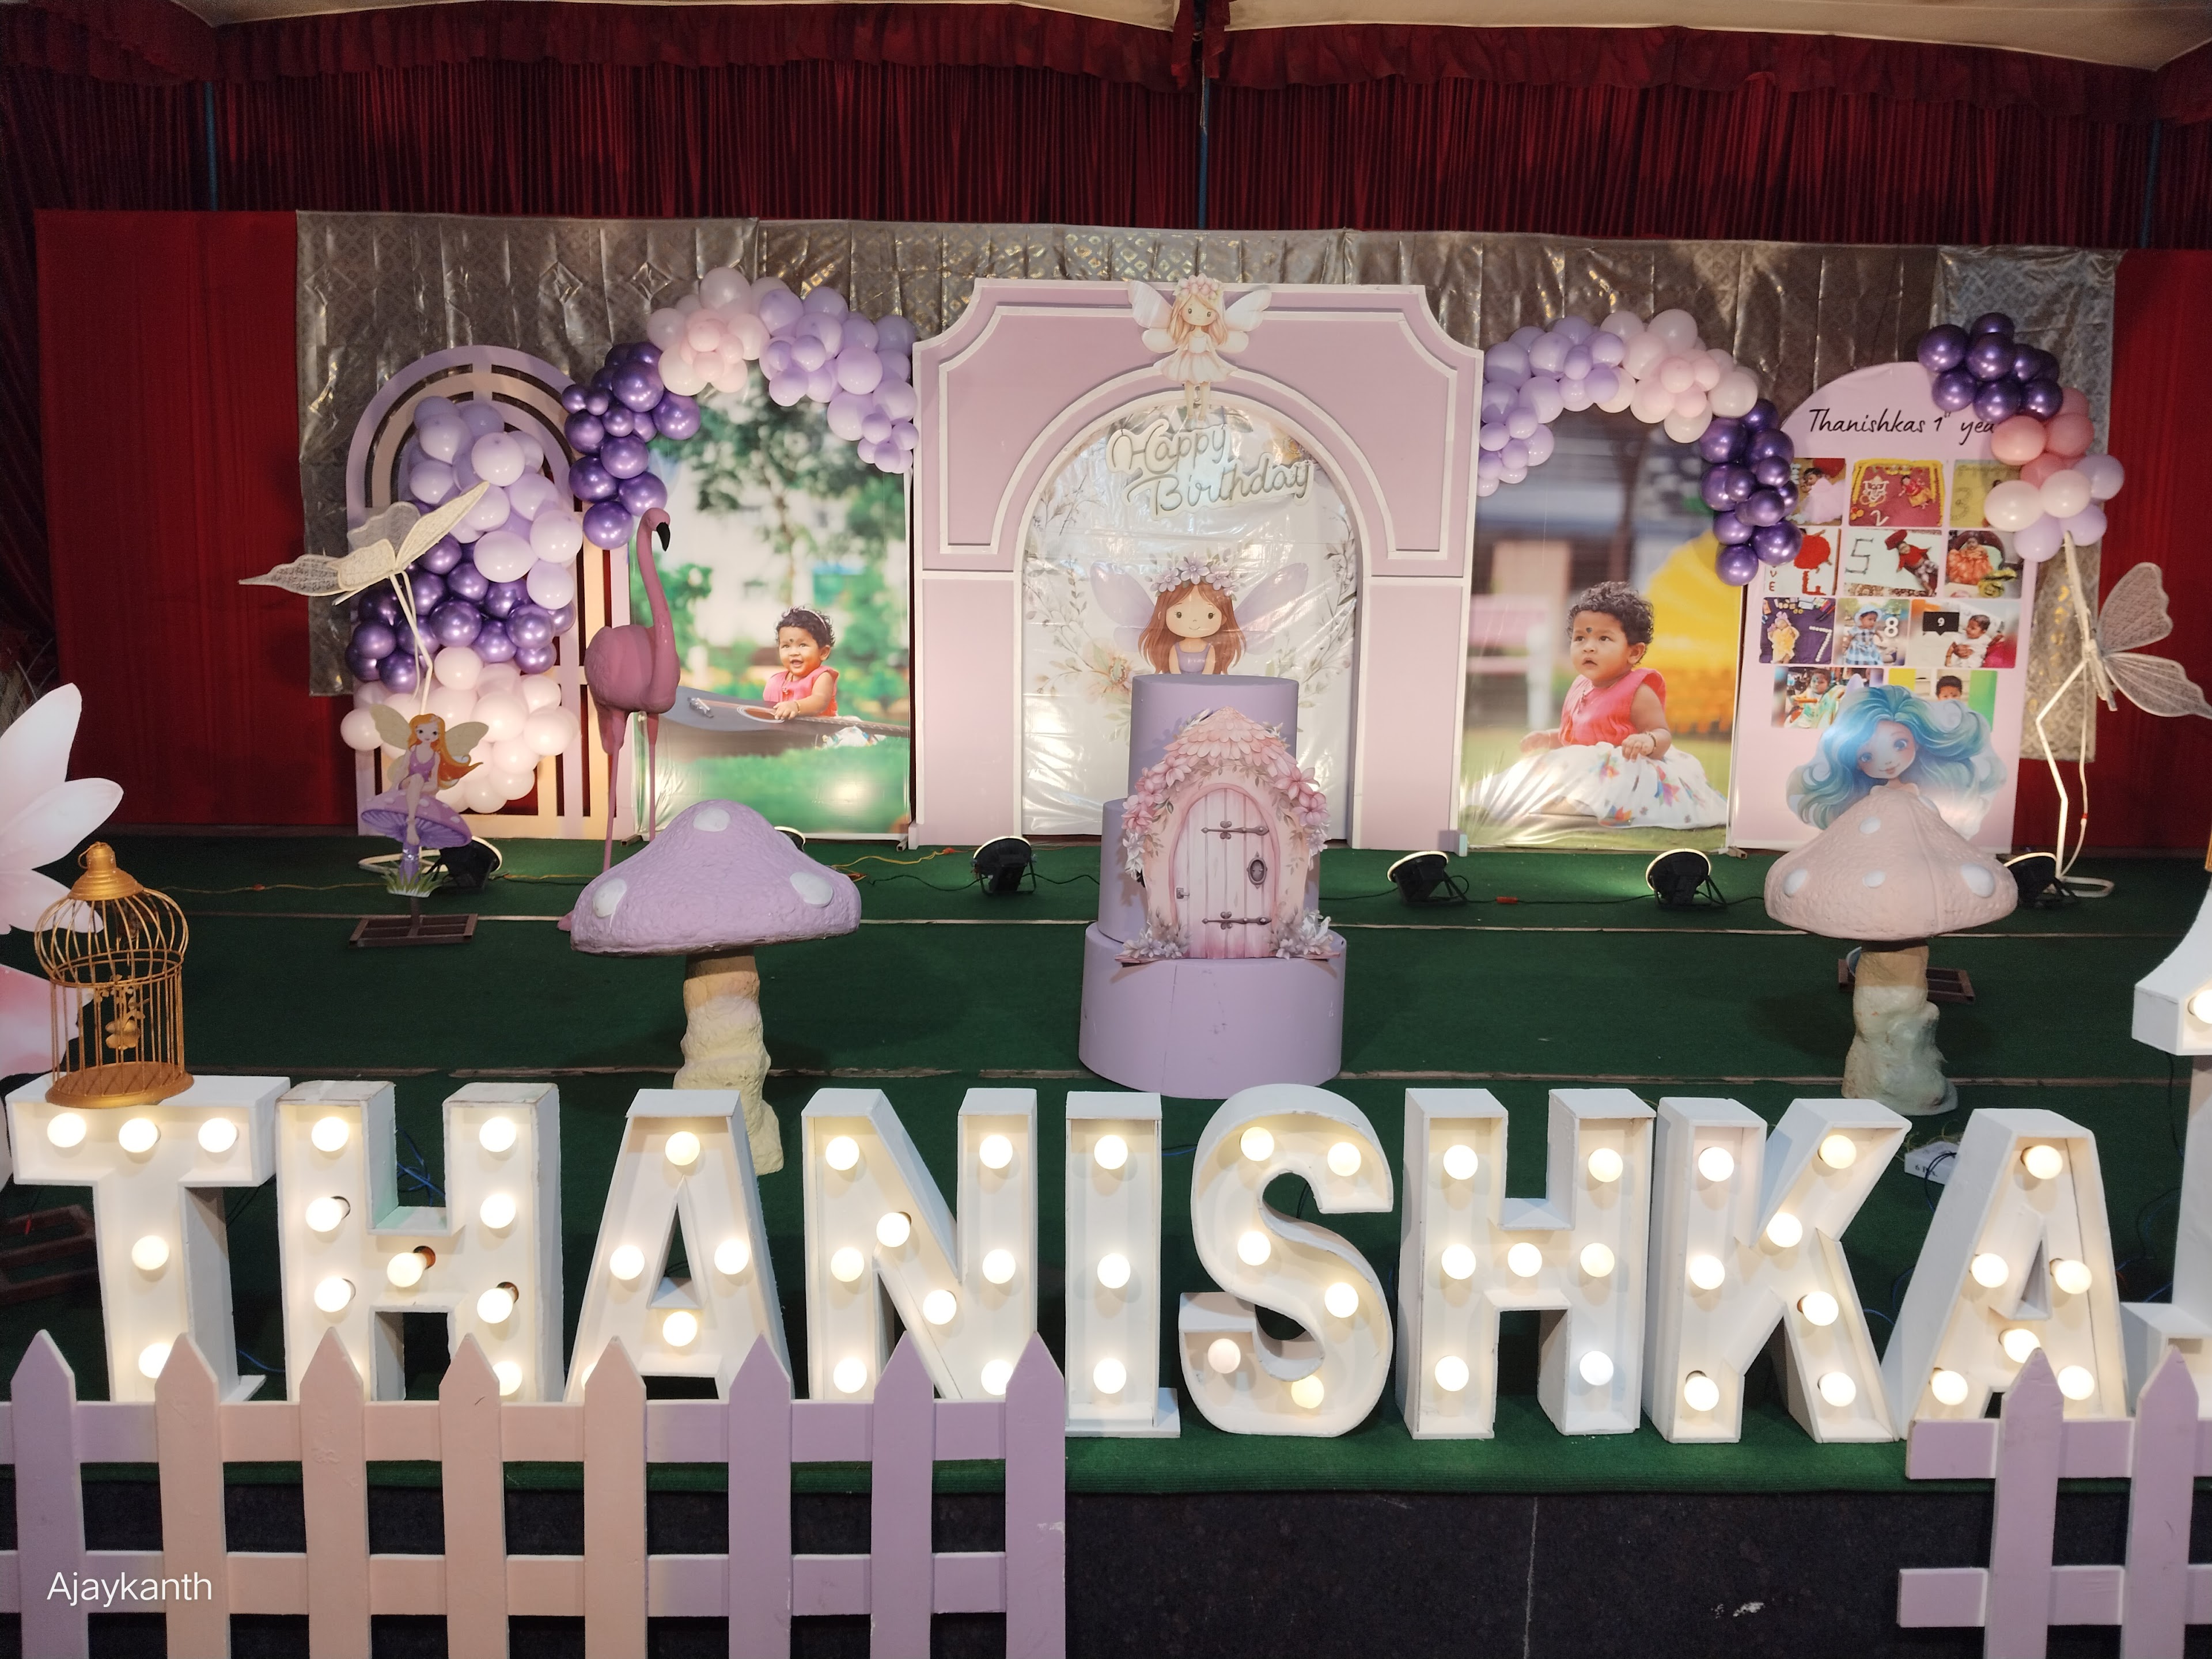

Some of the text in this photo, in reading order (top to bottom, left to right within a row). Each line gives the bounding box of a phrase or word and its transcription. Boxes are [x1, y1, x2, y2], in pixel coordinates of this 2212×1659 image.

[1111, 423, 1227, 472] Happy
[1809, 408, 1926, 433] Thanishkas
[1959, 421, 1995, 446] yea
[1126, 456, 1310, 516] Birthday
[1884, 616, 1899, 638] 8
[1937, 617, 1945, 627] 9
[6, 1075, 2130, 1444] THANISHKA
